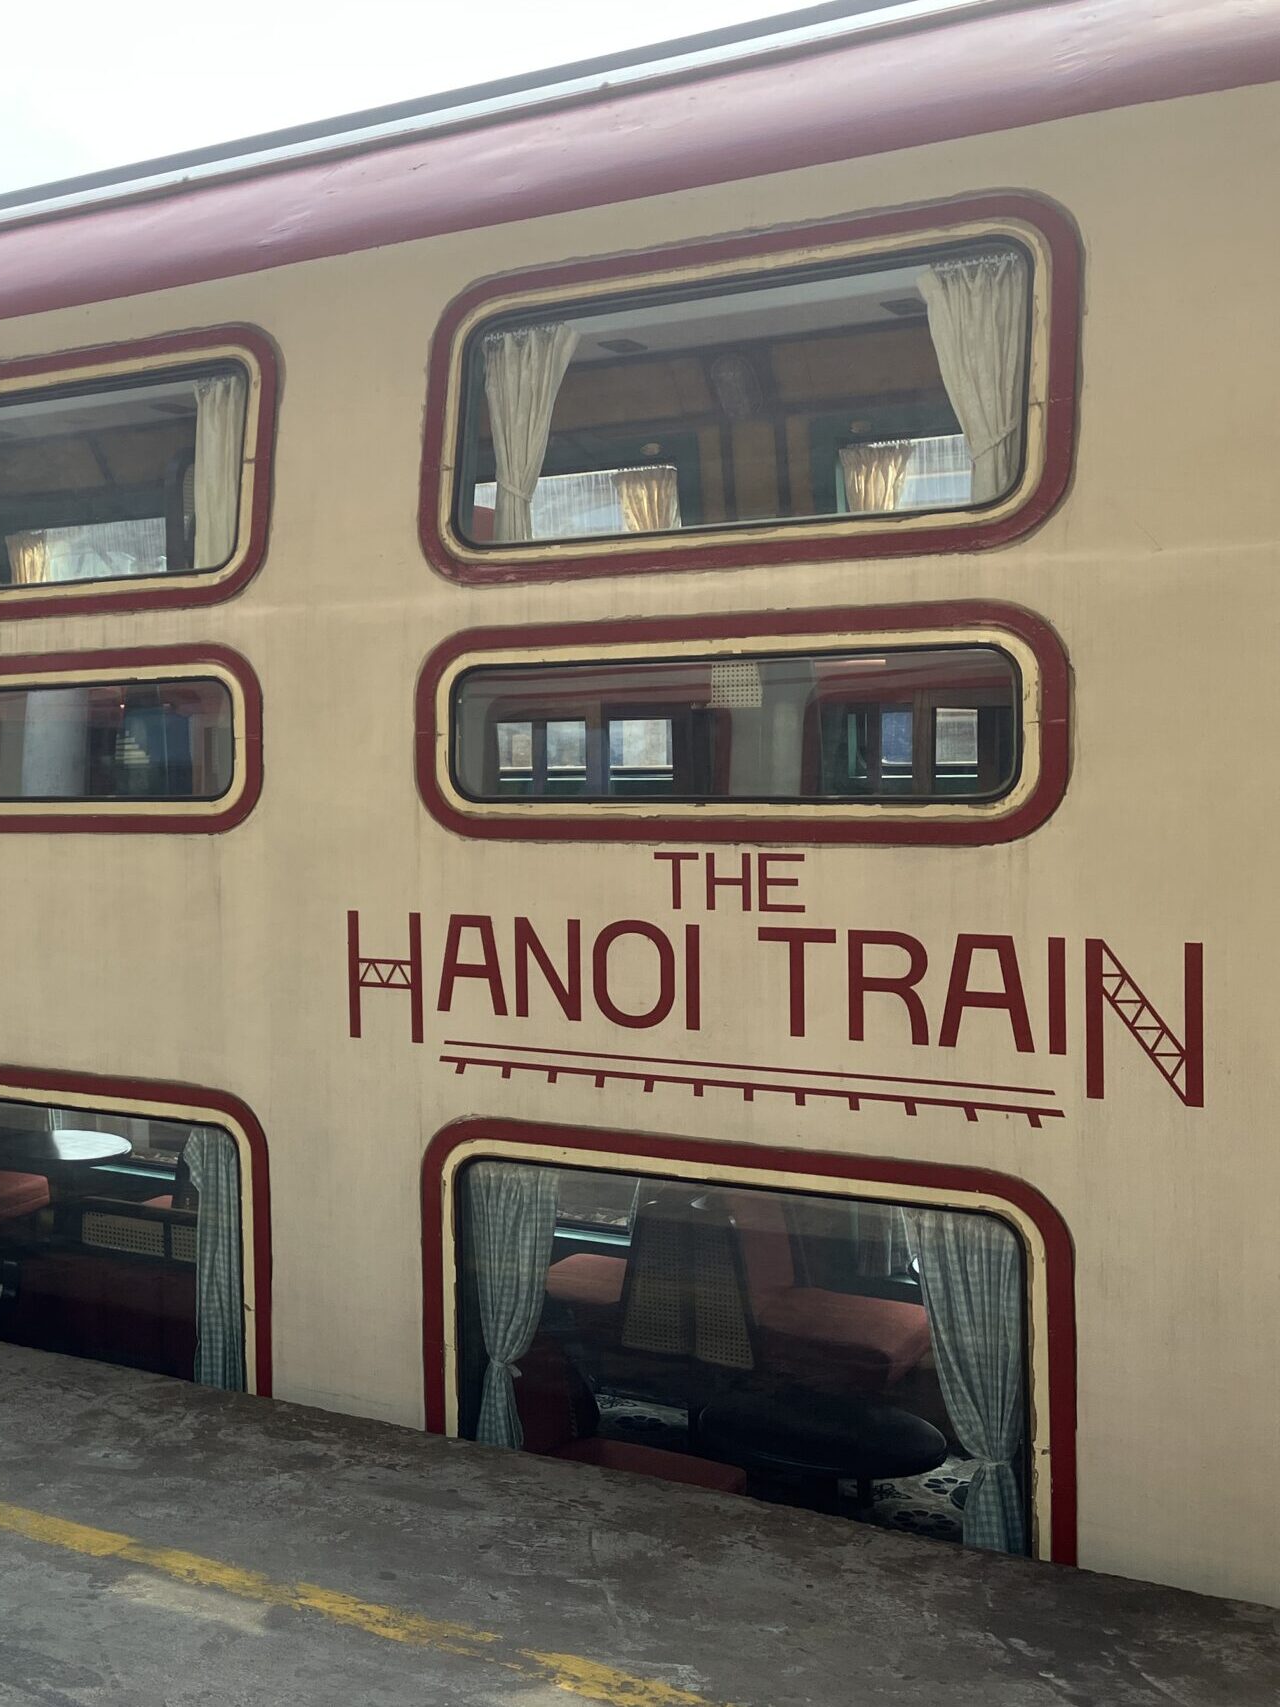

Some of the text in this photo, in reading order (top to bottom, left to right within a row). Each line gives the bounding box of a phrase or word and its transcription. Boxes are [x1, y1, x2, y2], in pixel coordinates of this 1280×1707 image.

[653, 851, 806, 913] THE
[347, 909, 1206, 1108] HANOI TRAIN
